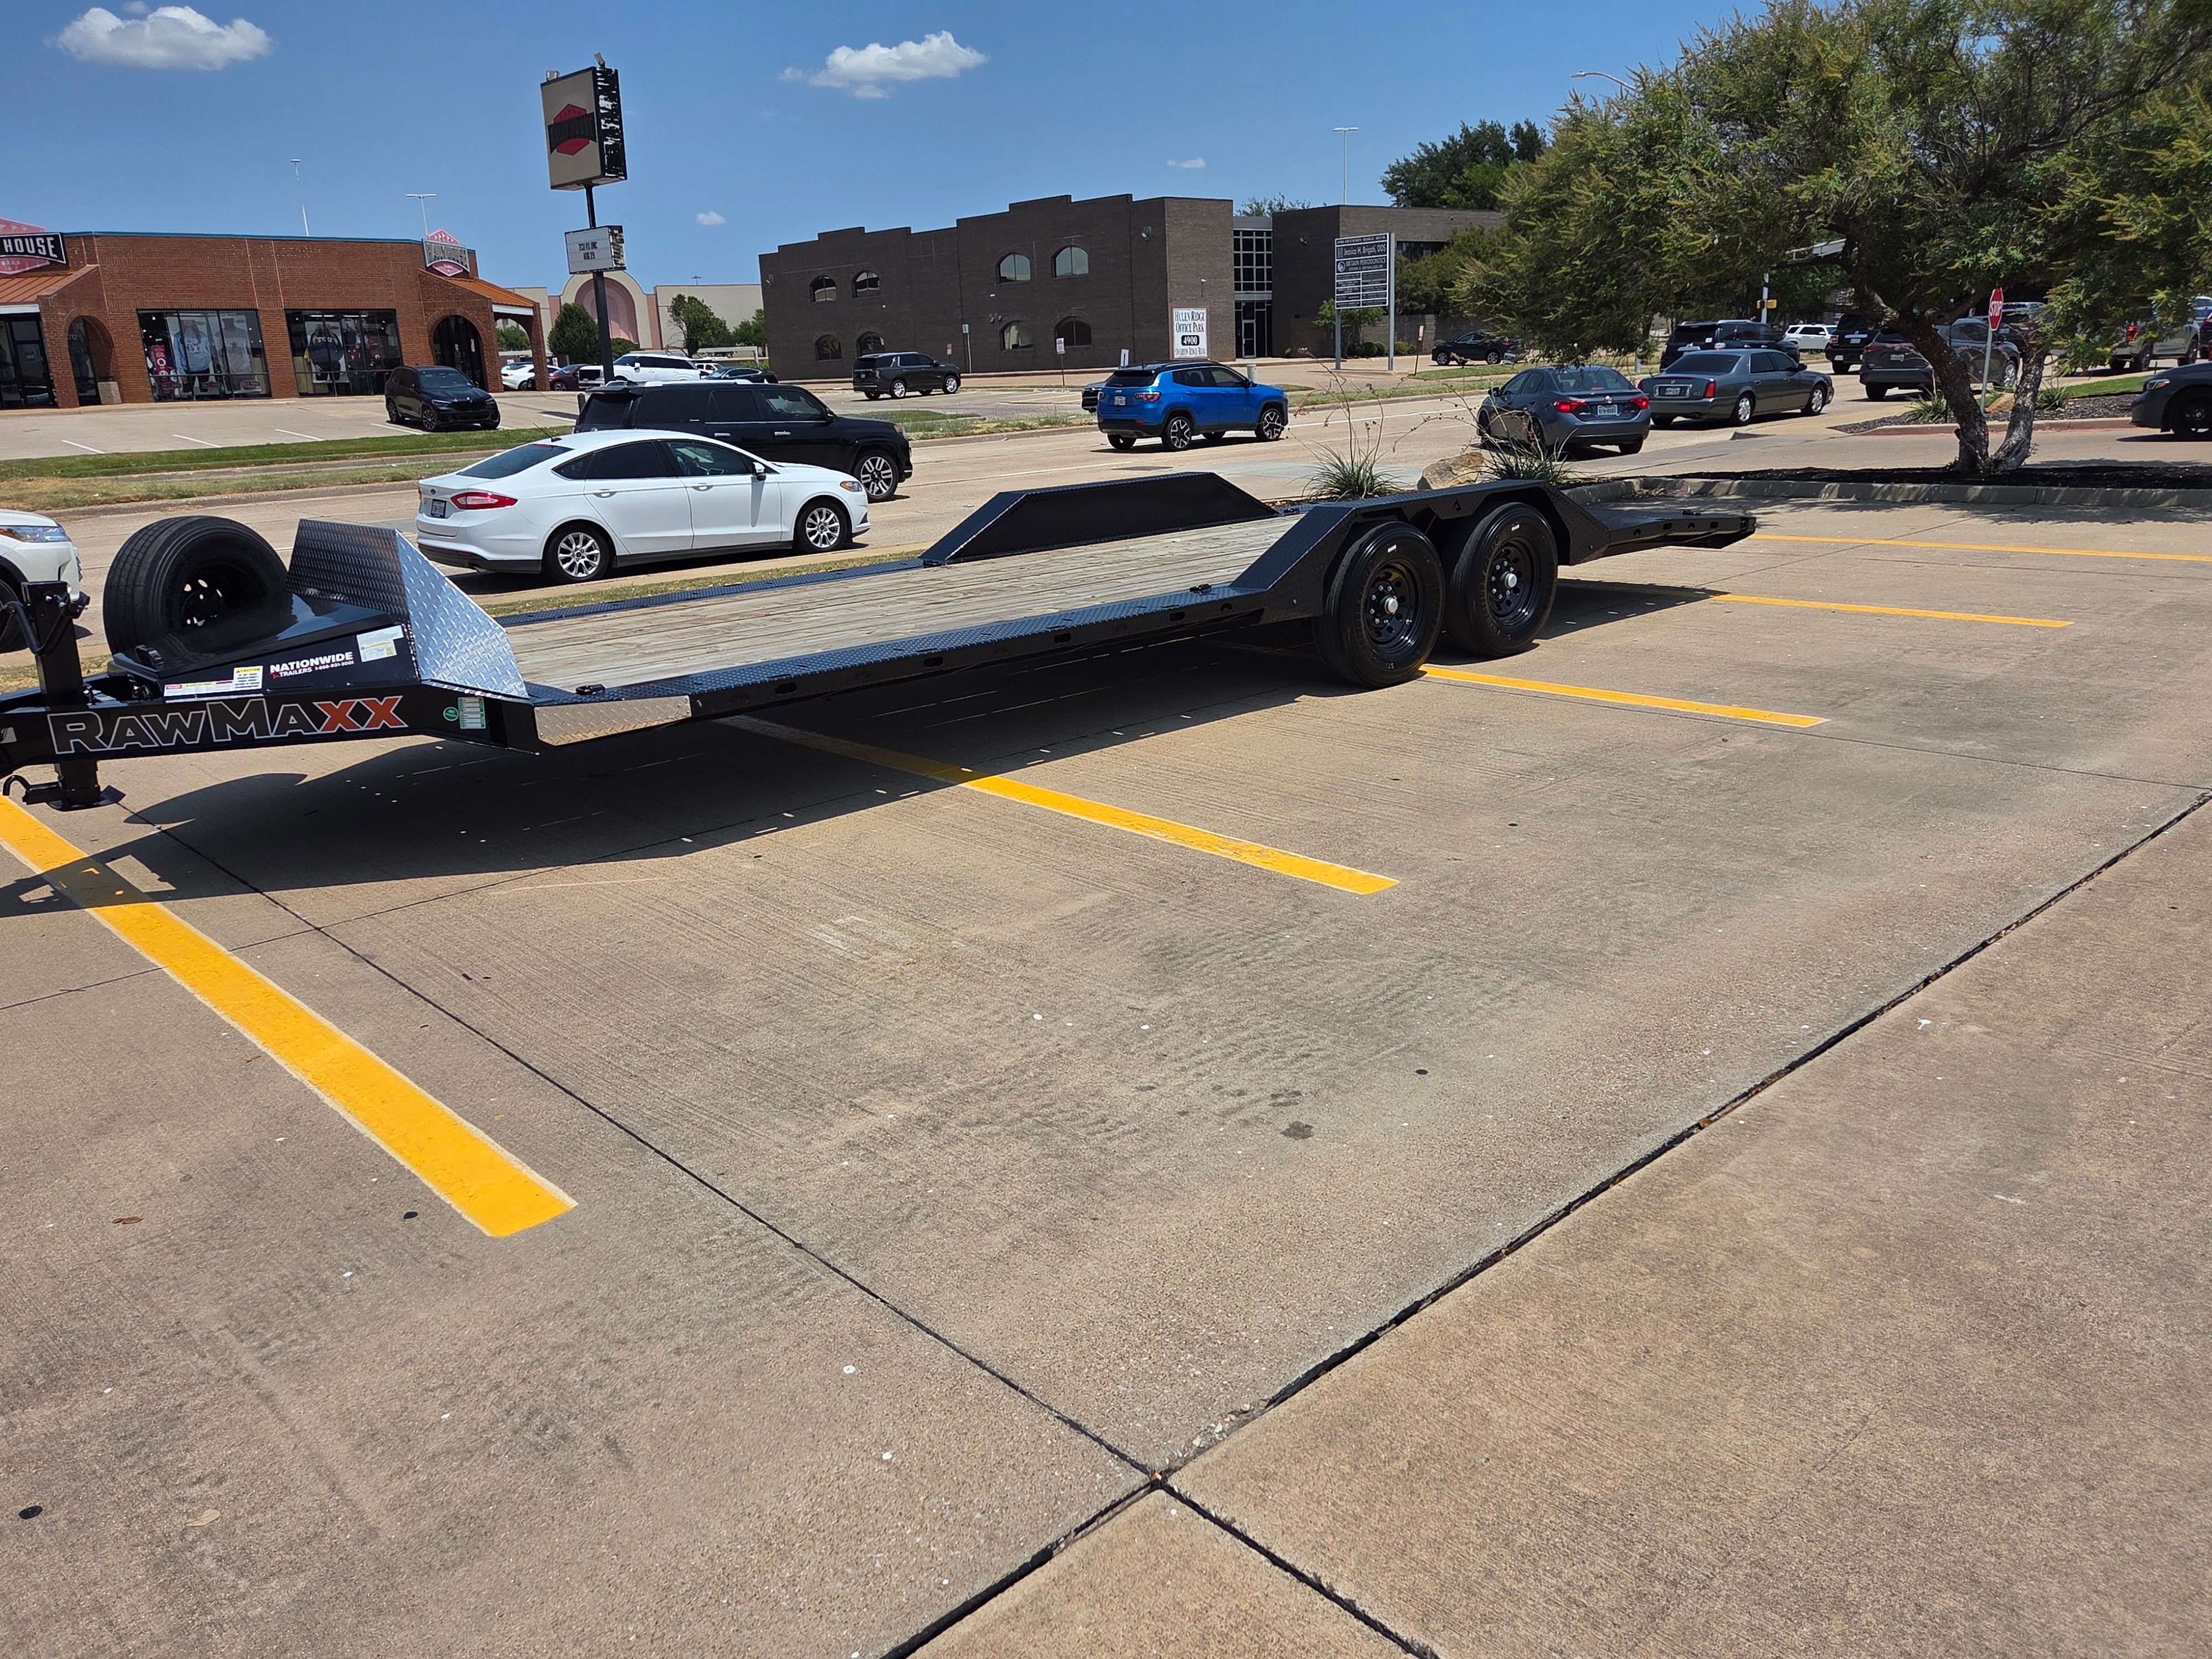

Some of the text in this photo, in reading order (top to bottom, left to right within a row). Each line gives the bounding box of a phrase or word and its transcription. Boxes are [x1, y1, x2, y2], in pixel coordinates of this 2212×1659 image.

[3, 237, 58, 258] HOUSE
[1344, 247, 1357, 255] Jessica
[1377, 243, 1386, 252] DDS
[1990, 300, 2002, 317] STOP
[1176, 322, 1192, 333] OFFICE
[1183, 336, 1198, 345] 4900
[270, 651, 353, 673] NATIONWIDE
[279, 667, 313, 677] TRAILERS
